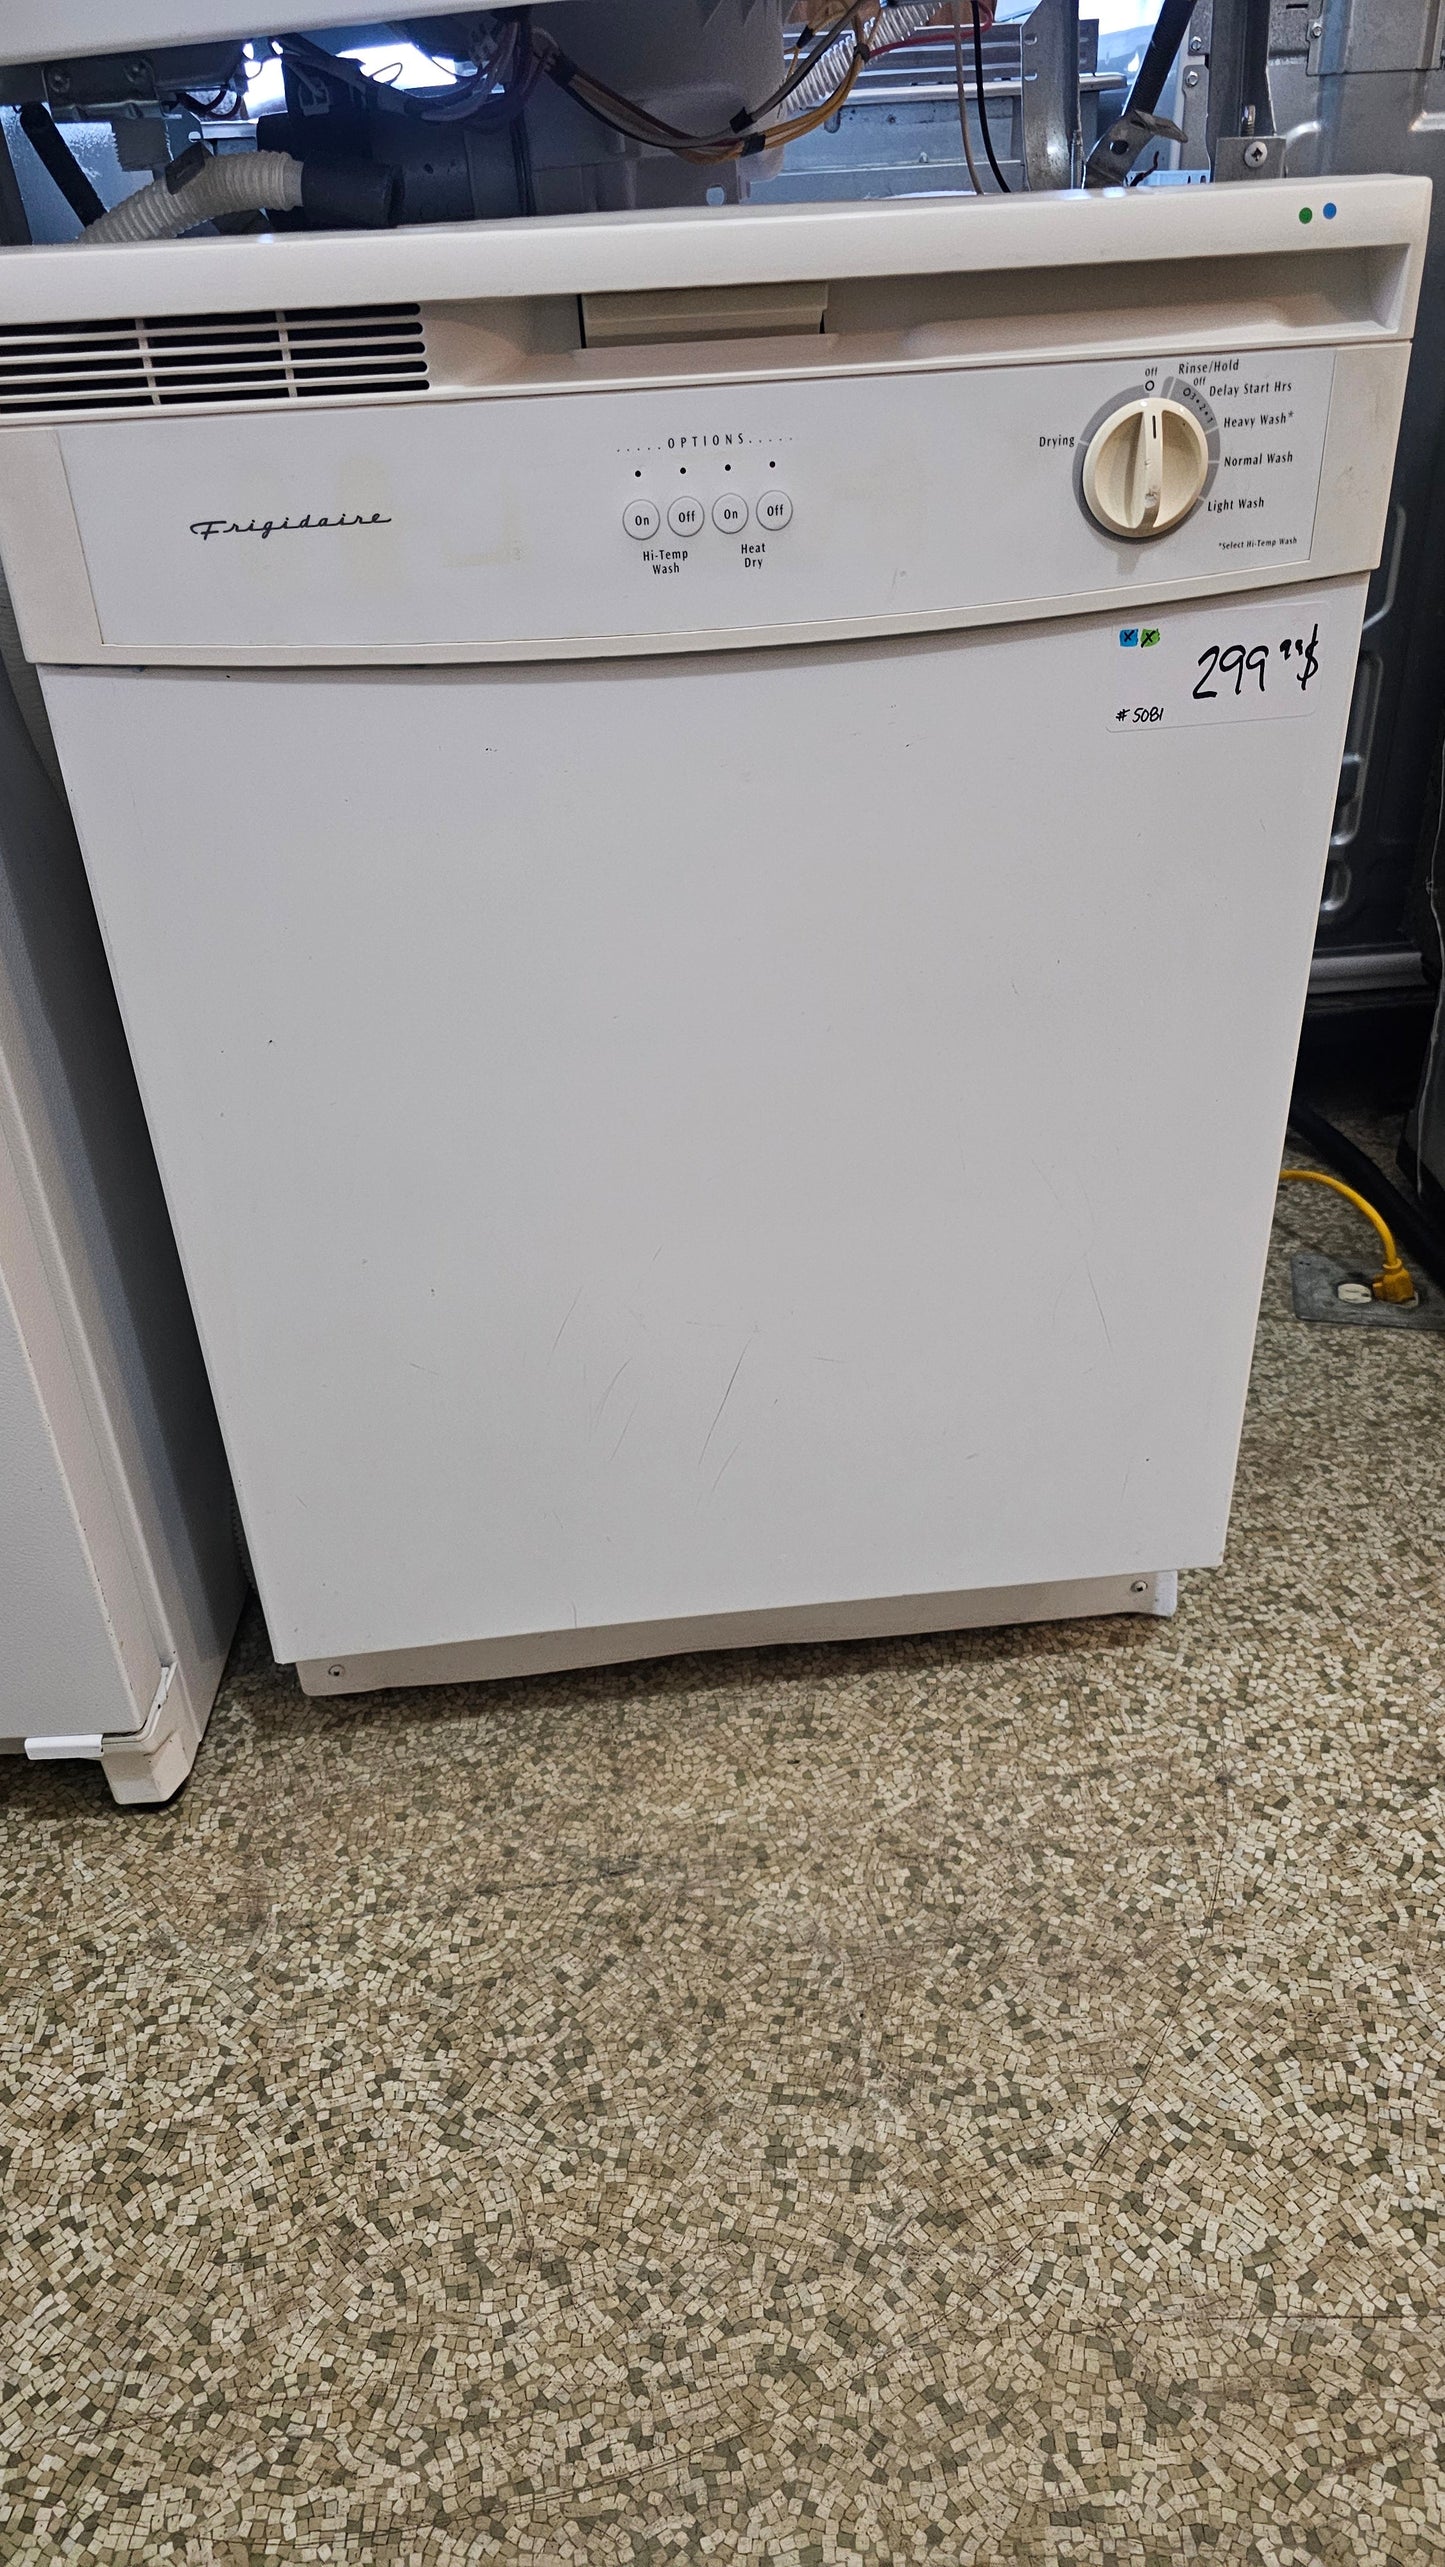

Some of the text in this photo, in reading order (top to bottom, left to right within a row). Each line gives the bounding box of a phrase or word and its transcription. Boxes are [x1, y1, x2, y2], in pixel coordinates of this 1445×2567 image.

[1144, 367, 1158, 377] Off
[1178, 359, 1240, 375] Rinse/Hold
[1193, 376, 1206, 386] Off
[1209, 381, 1292, 398] Delay Start Hrs
[1223, 417, 1256, 429] Heavy
[667, 432, 744, 449] OPTIONS
[1039, 435, 1075, 447] Drying
[1223, 451, 1293, 467] Normal Wash
[767, 504, 784, 517] Off
[1207, 496, 1265, 513] Light Wash
[634, 515, 650, 526] On
[678, 510, 696, 523] Off
[723, 508, 739, 520] On
[189, 513, 392, 541] Frigidaire
[741, 543, 766, 554] Heat
[1246, 539, 1276, 548] Hi-Temp
[1279, 536, 1298, 545] Wash
[643, 549, 689, 562] Hi-Temp
[652, 562, 680, 575] Wash
[744, 557, 763, 569] Dry
